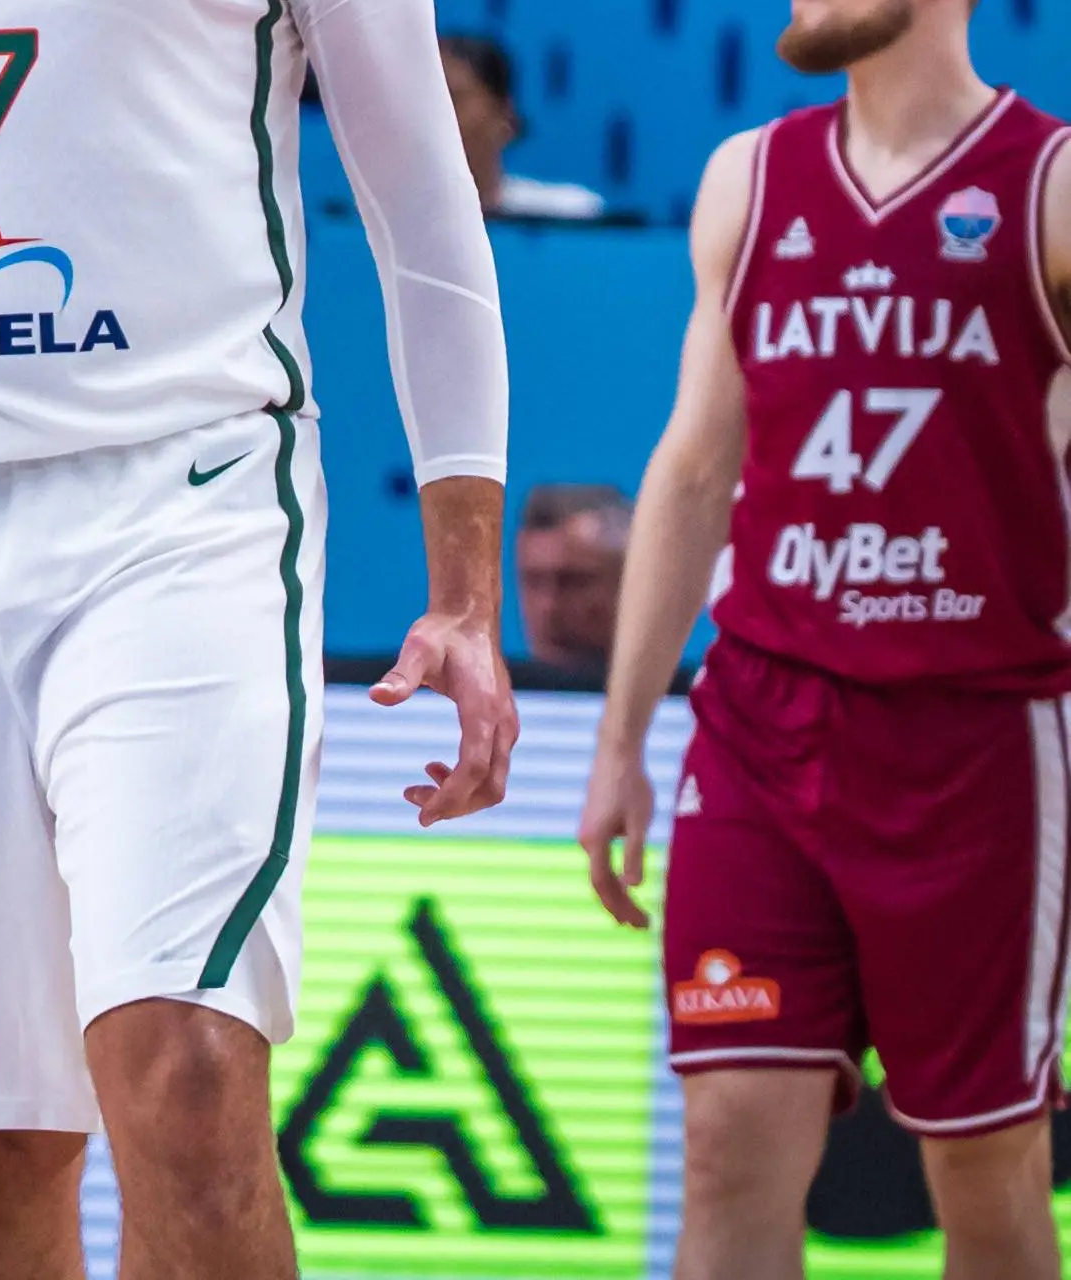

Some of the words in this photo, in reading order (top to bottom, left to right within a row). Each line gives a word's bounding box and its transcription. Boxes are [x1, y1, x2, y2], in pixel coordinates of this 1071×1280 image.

[754, 295, 1000, 365] LATVIJA
[790, 388, 944, 492] 47
[770, 522, 947, 600] OlyBet
[840, 590, 927, 628] Sports
[933, 588, 986, 620] Bar
